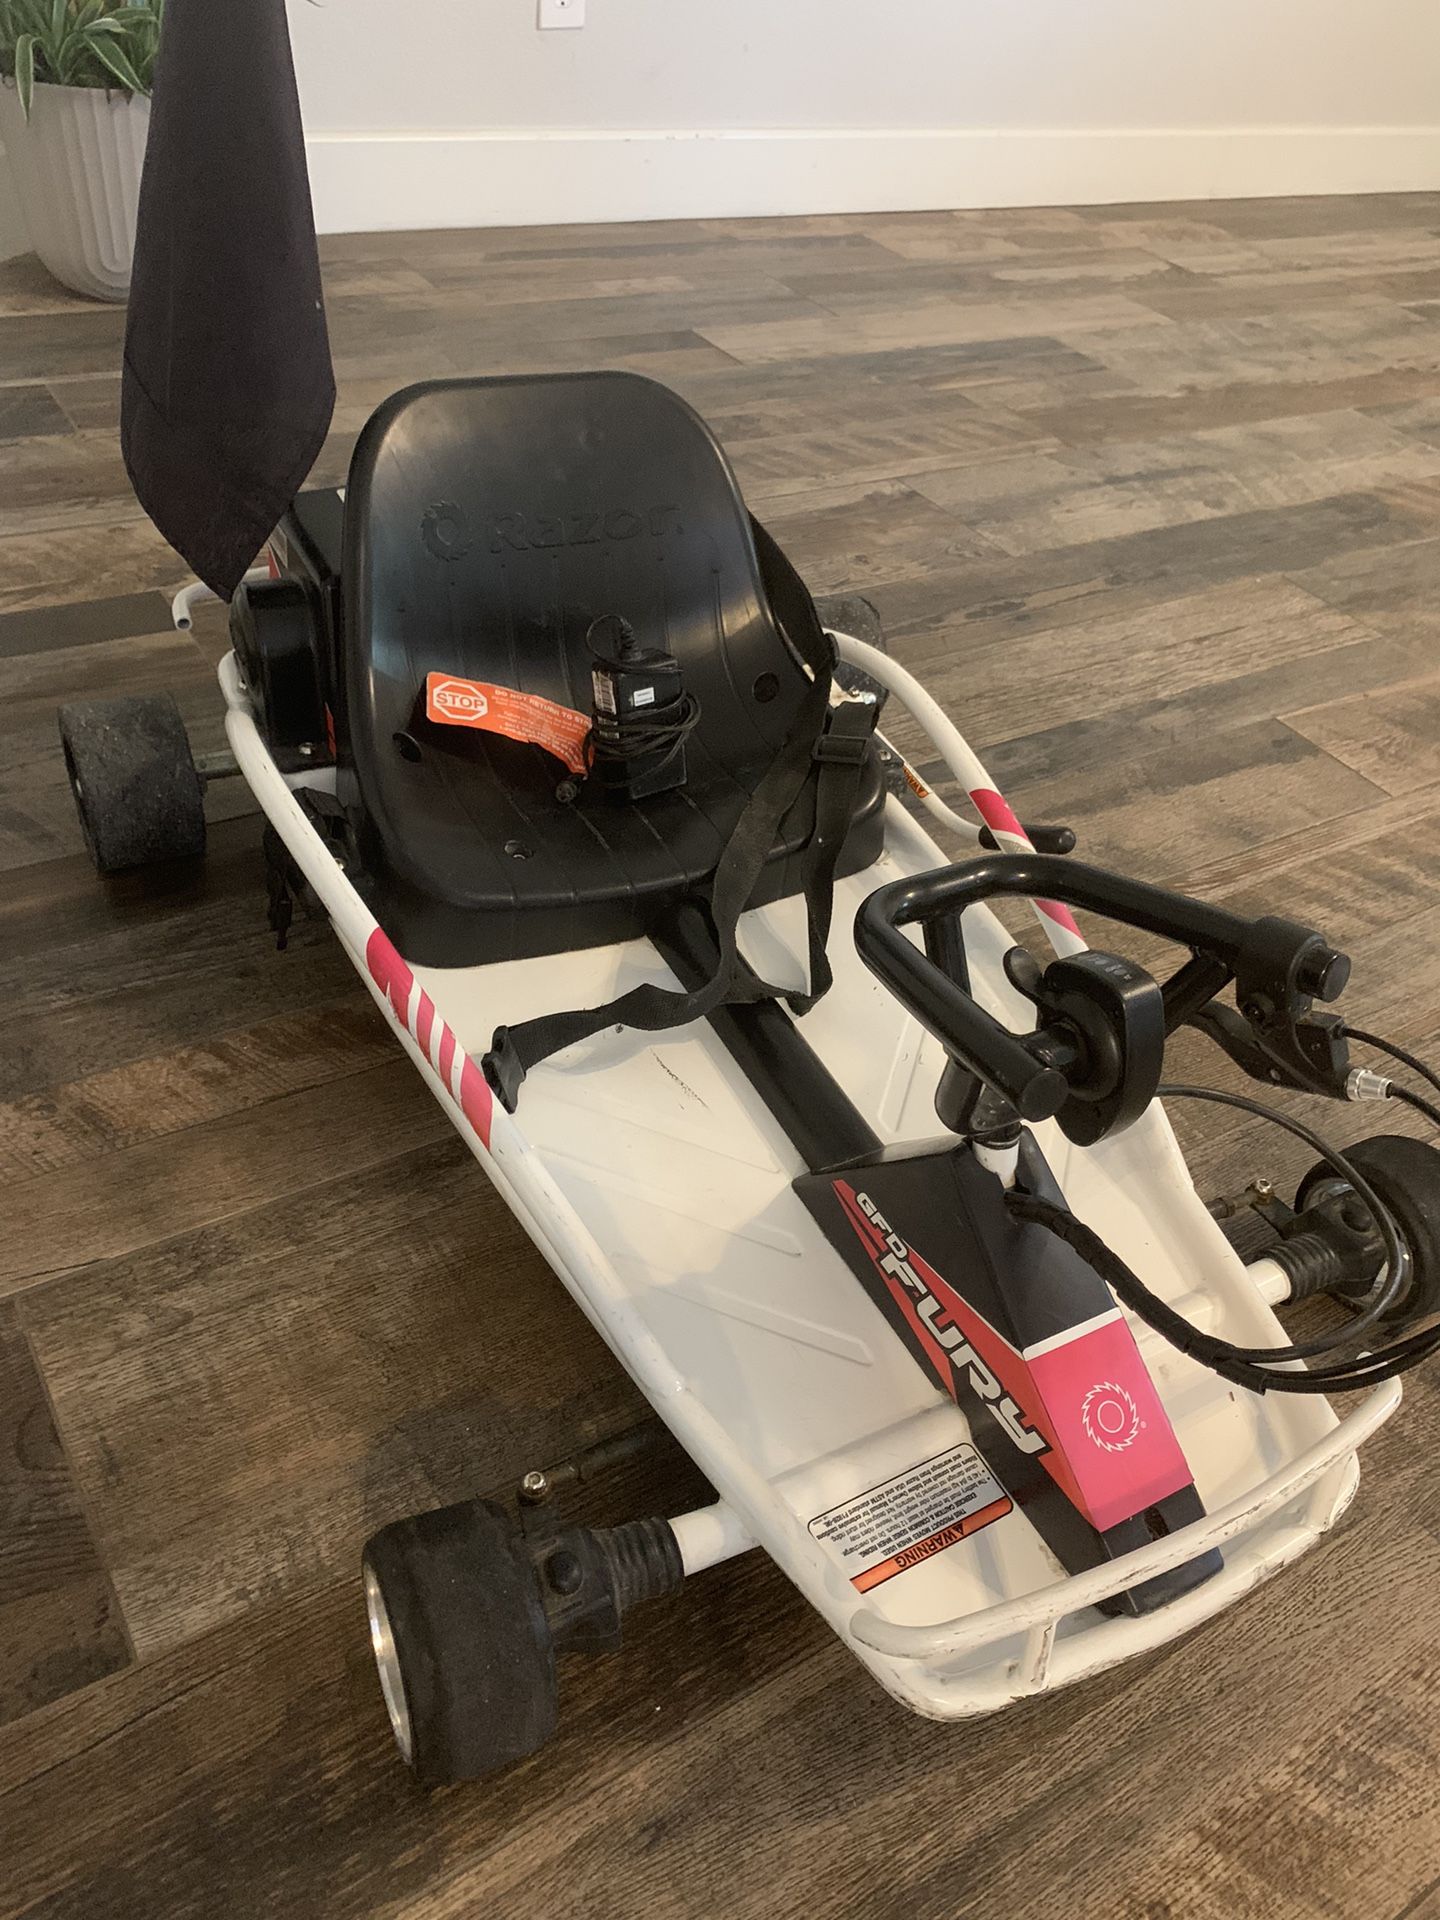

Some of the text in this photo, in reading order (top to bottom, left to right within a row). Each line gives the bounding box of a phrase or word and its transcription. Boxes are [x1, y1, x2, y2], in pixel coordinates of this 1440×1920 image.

[491, 505, 680, 553] Razor
[436, 692, 484, 709] STOP
[494, 689, 508, 697] DO
[510, 693, 527, 701] NOT
[529, 698, 560, 715] RETURN
[561, 712, 573, 720] TO
[855, 1191, 1047, 1455] GFD FURY
[959, 1481, 979, 1495] battery
[868, 1492, 886, 1504] ASTM
[932, 1502, 956, 1519] CAUTION
[929, 1513, 955, 1531] PRODUCT
[891, 1527, 910, 1541] SENSE
[895, 1535, 913, 1548] WHEN
[911, 1526, 932, 1540] MOVES
[875, 1535, 894, 1549] WHEN
[893, 1528, 958, 1568] WARNING
